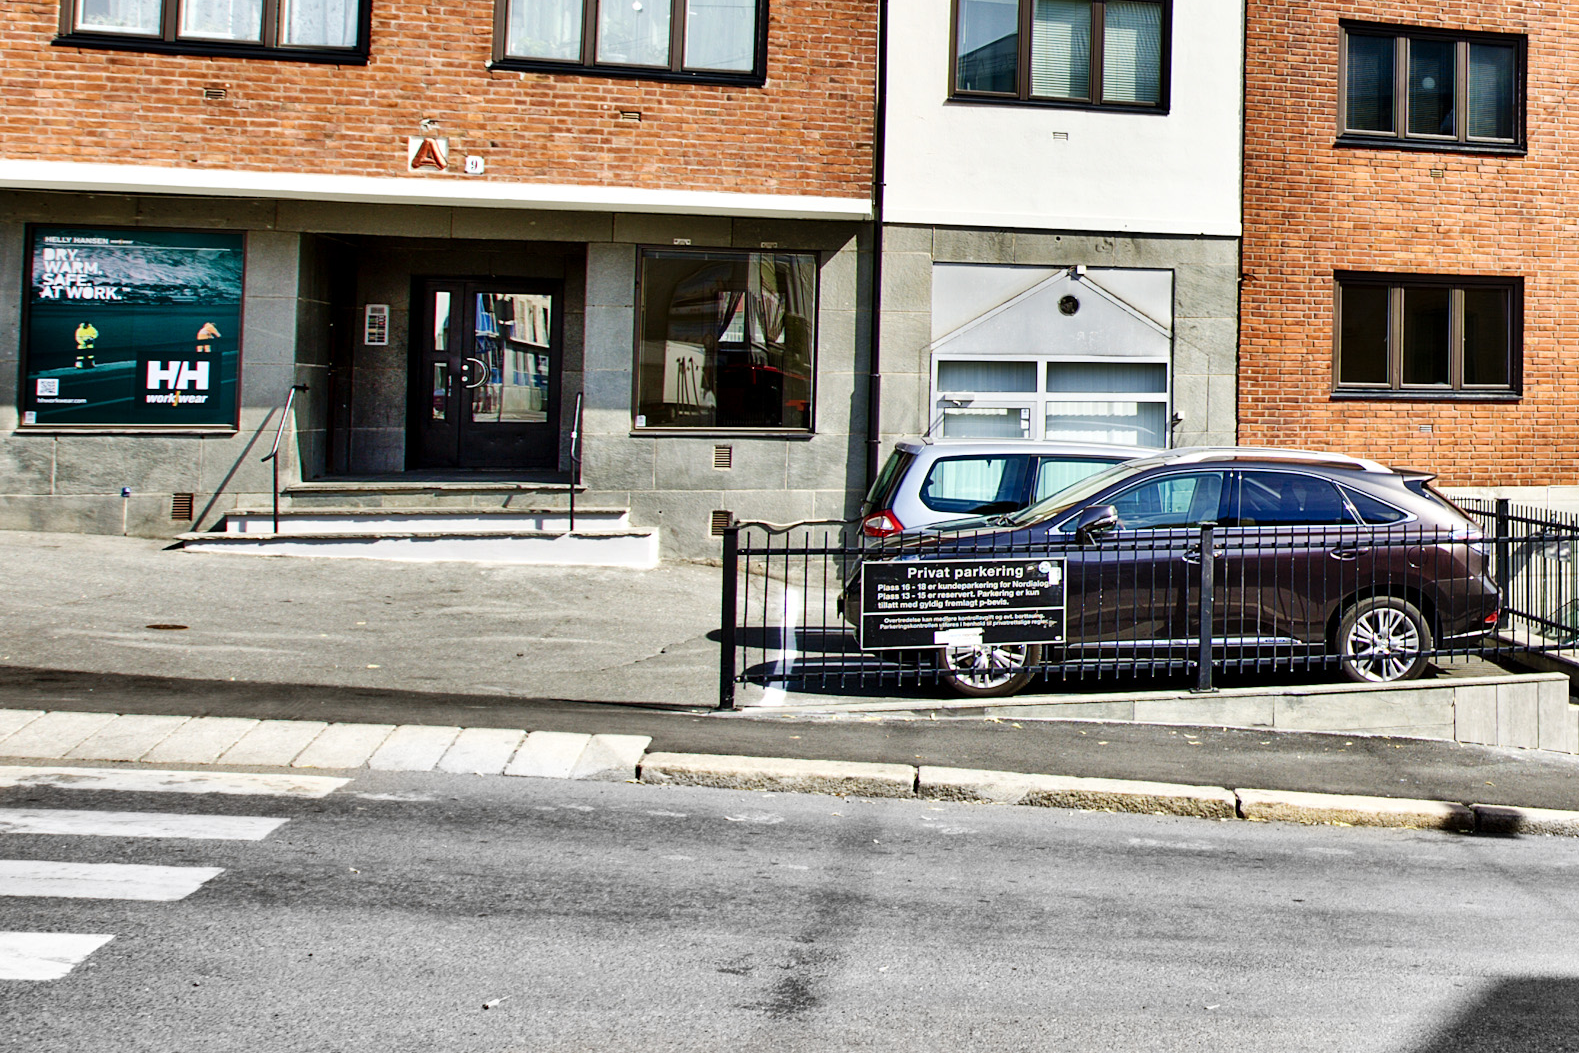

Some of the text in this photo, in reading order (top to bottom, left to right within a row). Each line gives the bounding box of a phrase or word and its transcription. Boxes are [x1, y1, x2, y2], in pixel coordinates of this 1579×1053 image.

[411, 137, 447, 170] A
[471, 159, 478, 170] 9
[43, 248, 81, 261] DRY.
[43, 260, 104, 275] WARM.
[42, 273, 93, 286] SAFE.
[40, 286, 64, 298] AT
[146, 360, 210, 390] HH
[907, 565, 1024, 580] Privat parkering
[901, 583, 911, 591] 16
[937, 582, 999, 591] kundeparkering
[937, 591, 976, 599] reservert.
[977, 589, 1015, 598] Parkering
[877, 601, 899, 609] tillatt
[919, 600, 944, 609] gyldig
[944, 600, 978, 608] fremlagt
[979, 598, 1010, 607] p-bevis.
